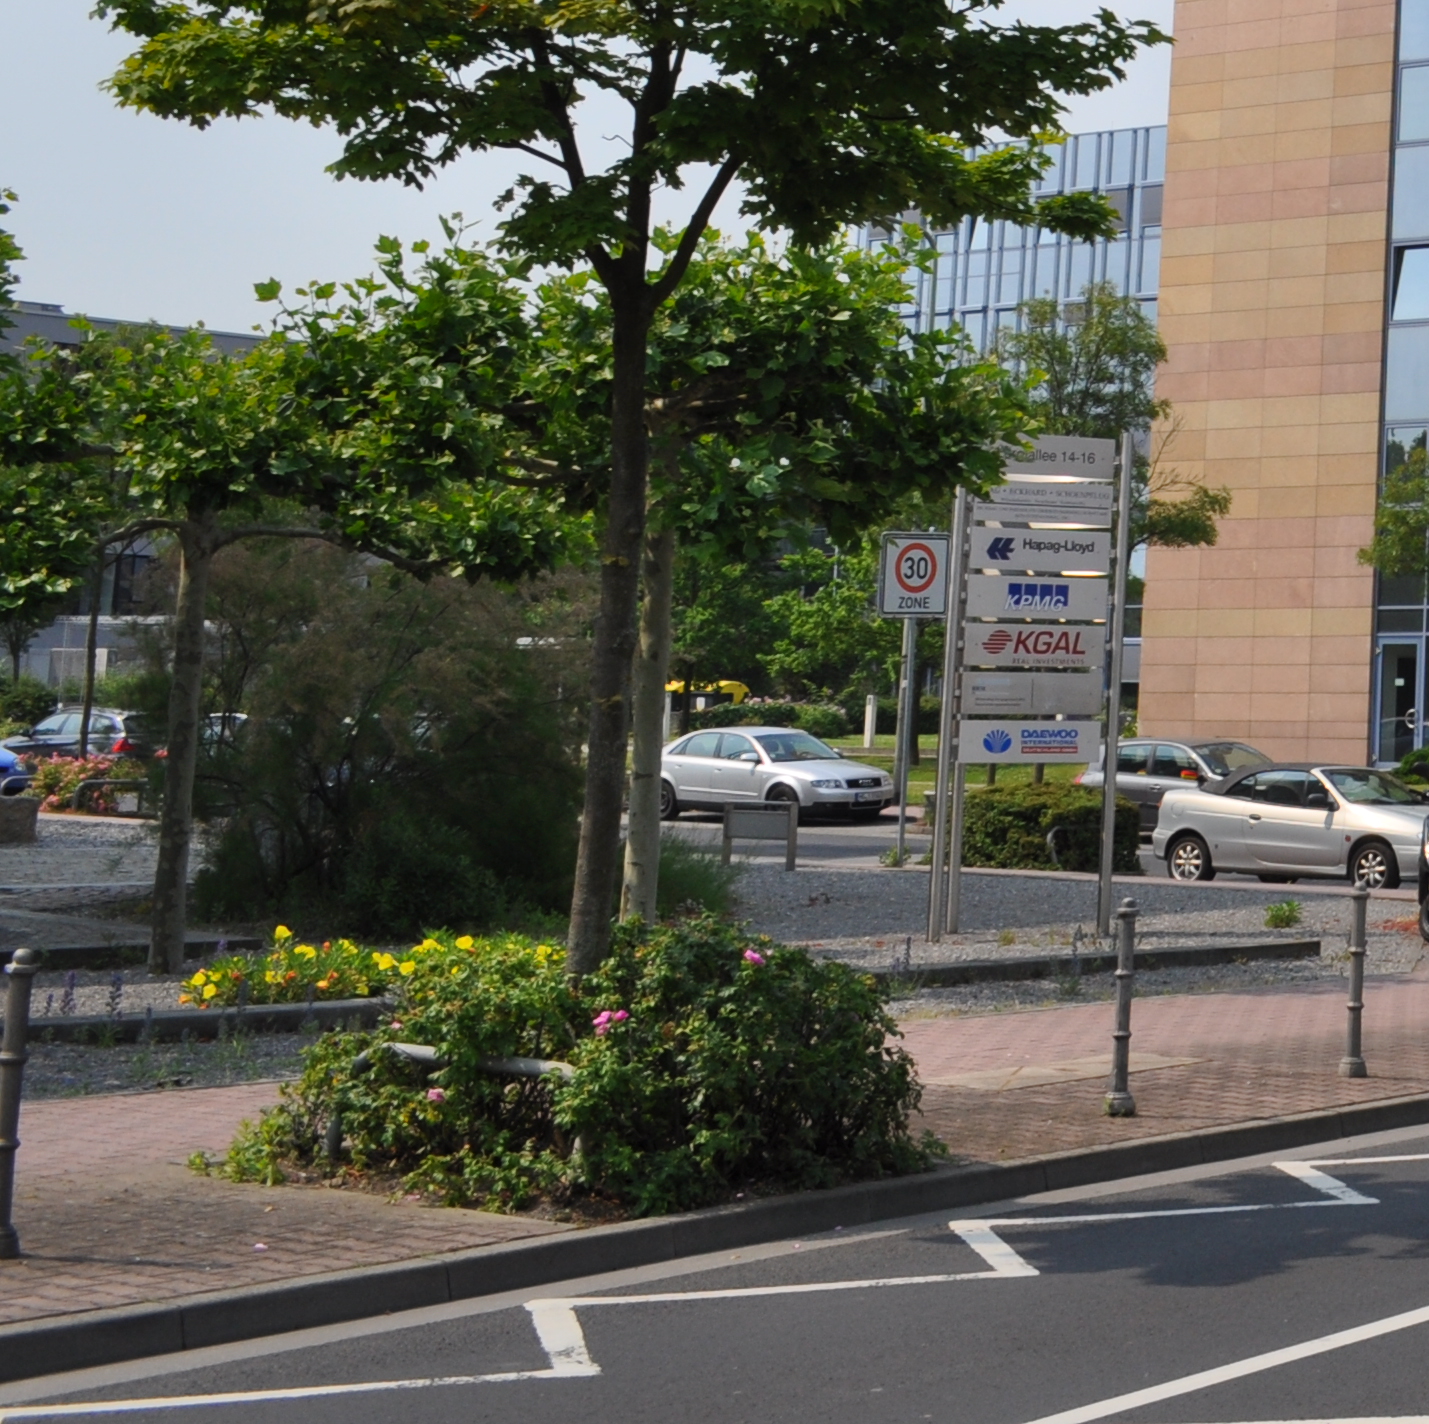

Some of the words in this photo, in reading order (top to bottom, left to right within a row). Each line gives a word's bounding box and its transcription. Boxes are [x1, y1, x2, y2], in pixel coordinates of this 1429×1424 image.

[1061, 451, 1096, 465] 14-16
[1022, 537, 1095, 555] Hapag-Lloyd
[903, 556, 929, 580] 30
[898, 596, 930, 610] ZONE
[1004, 594, 1066, 612] KPMG
[1012, 629, 1087, 655] KGAL
[1032, 657, 1085, 666] INVESTMENTS
[1021, 728, 1079, 739] DAEWOO
